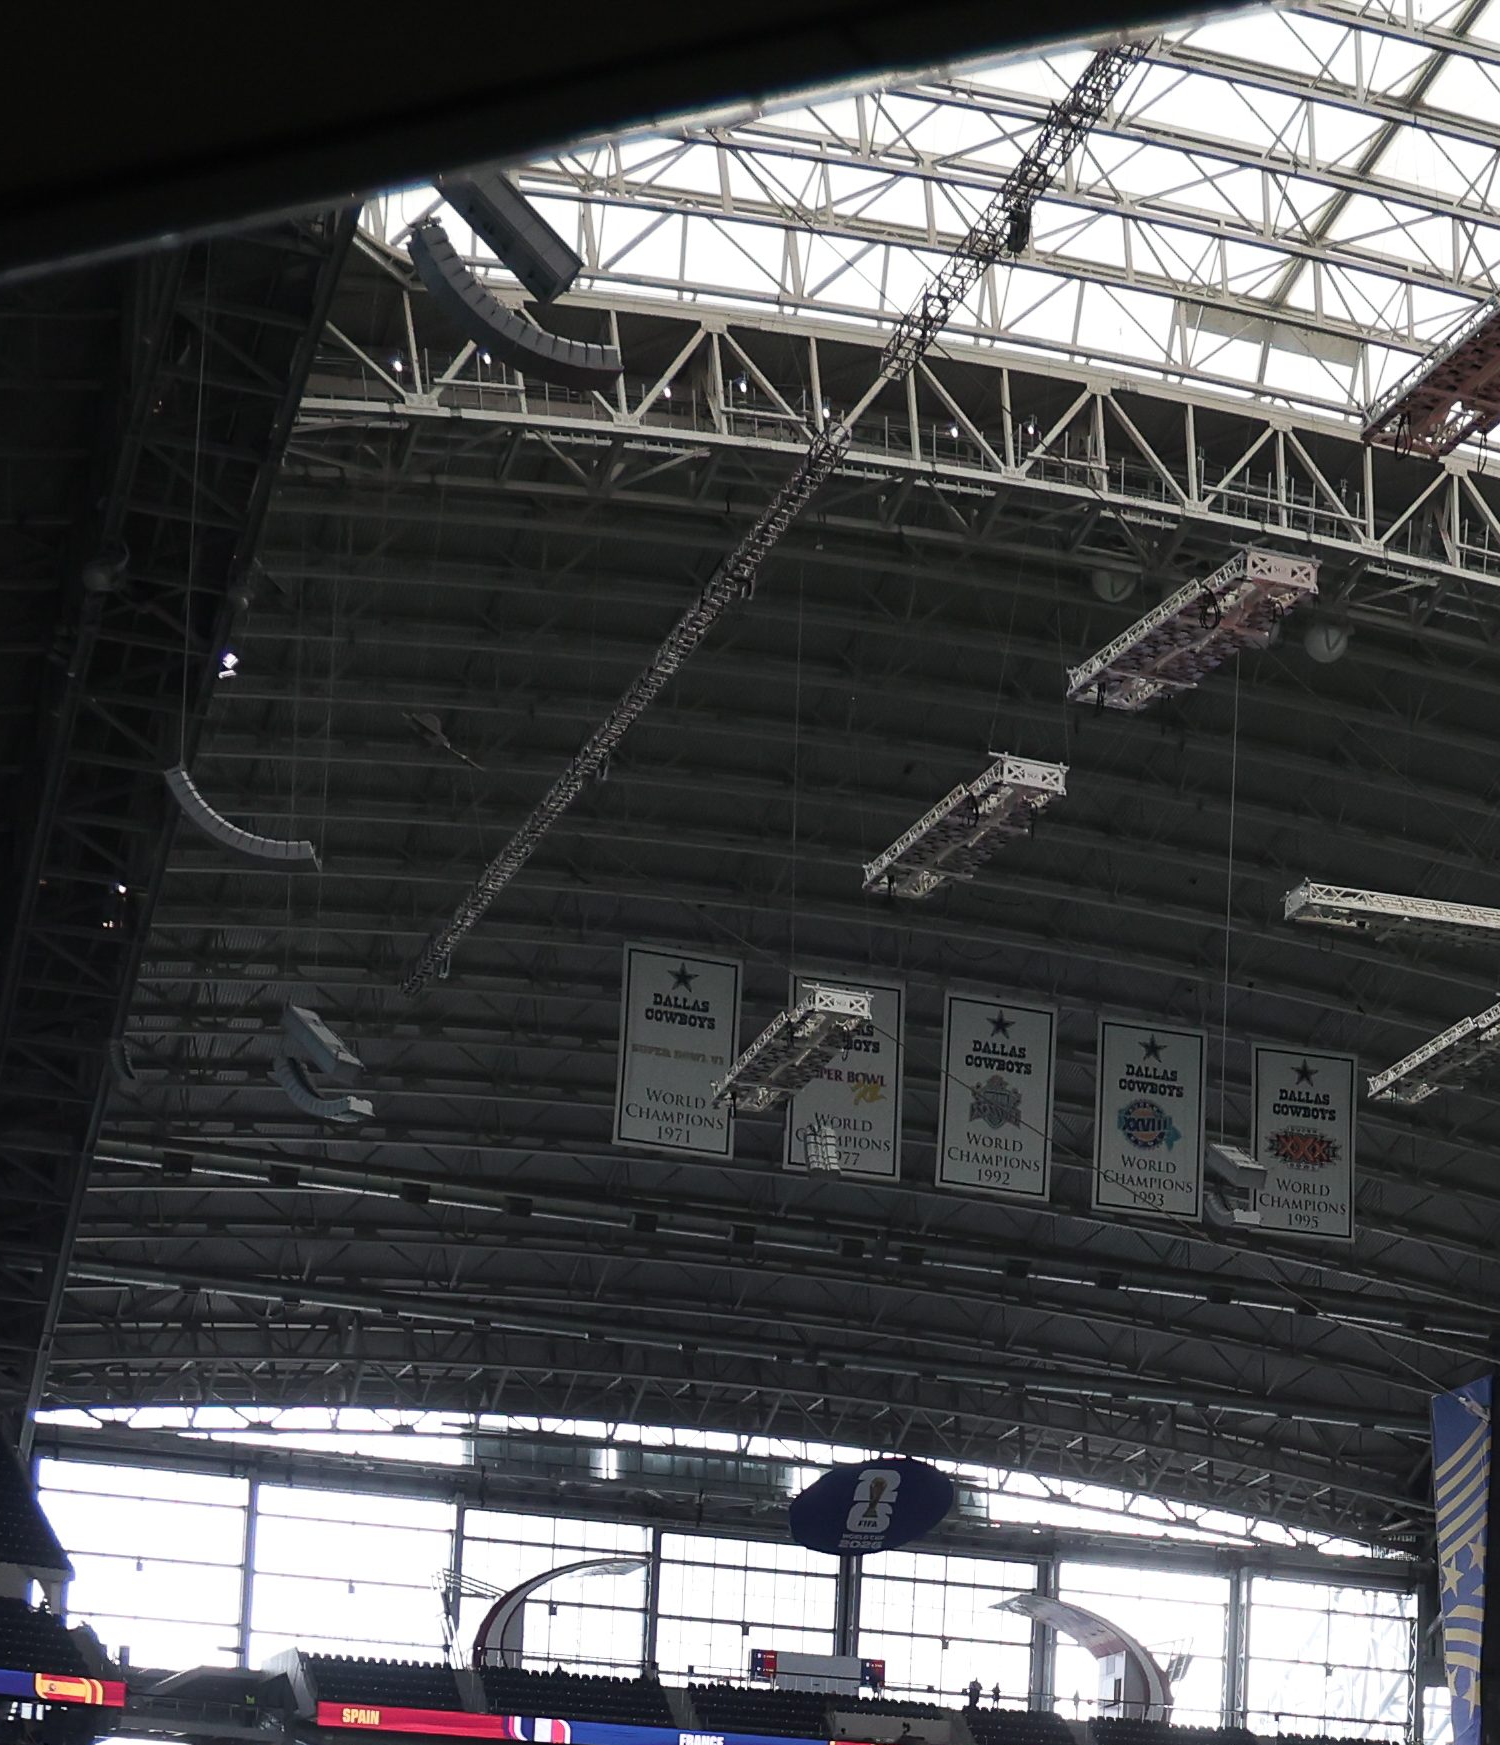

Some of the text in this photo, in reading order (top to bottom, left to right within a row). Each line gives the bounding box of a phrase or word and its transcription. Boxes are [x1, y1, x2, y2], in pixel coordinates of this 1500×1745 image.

[652, 993, 709, 1013] DALLAS
[645, 1007, 715, 1030] COWBOYS
[971, 1040, 1026, 1060] DALLAS
[966, 1053, 1031, 1075] COWBOYS
[1124, 1064, 1177, 1082] DALLAS
[1119, 1077, 1183, 1097] COWBOYS
[647, 1088, 705, 1110] WORLD
[1278, 1089, 1329, 1107] DALLAS
[626, 1101, 723, 1131] CHAMPIONS
[1273, 1102, 1336, 1121] COWBOYS
[656, 1126, 689, 1145] 1971
[967, 1132, 1022, 1152] WORLD
[946, 1145, 1041, 1174] CHAMPIONS
[1122, 1154, 1176, 1173] WORLD
[976, 1169, 1009, 1187] 1992
[1103, 1169, 1194, 1194] CHAMPIONS
[1277, 1178, 1330, 1196] WORLD
[1131, 1191, 1165, 1208] 1993
[1259, 1192, 1345, 1215] CHAMPIONS
[1289, 1214, 1318, 1228] 1995
[856, 1518, 880, 1530] FIFA
[343, 1708, 379, 1725] SPAIN
